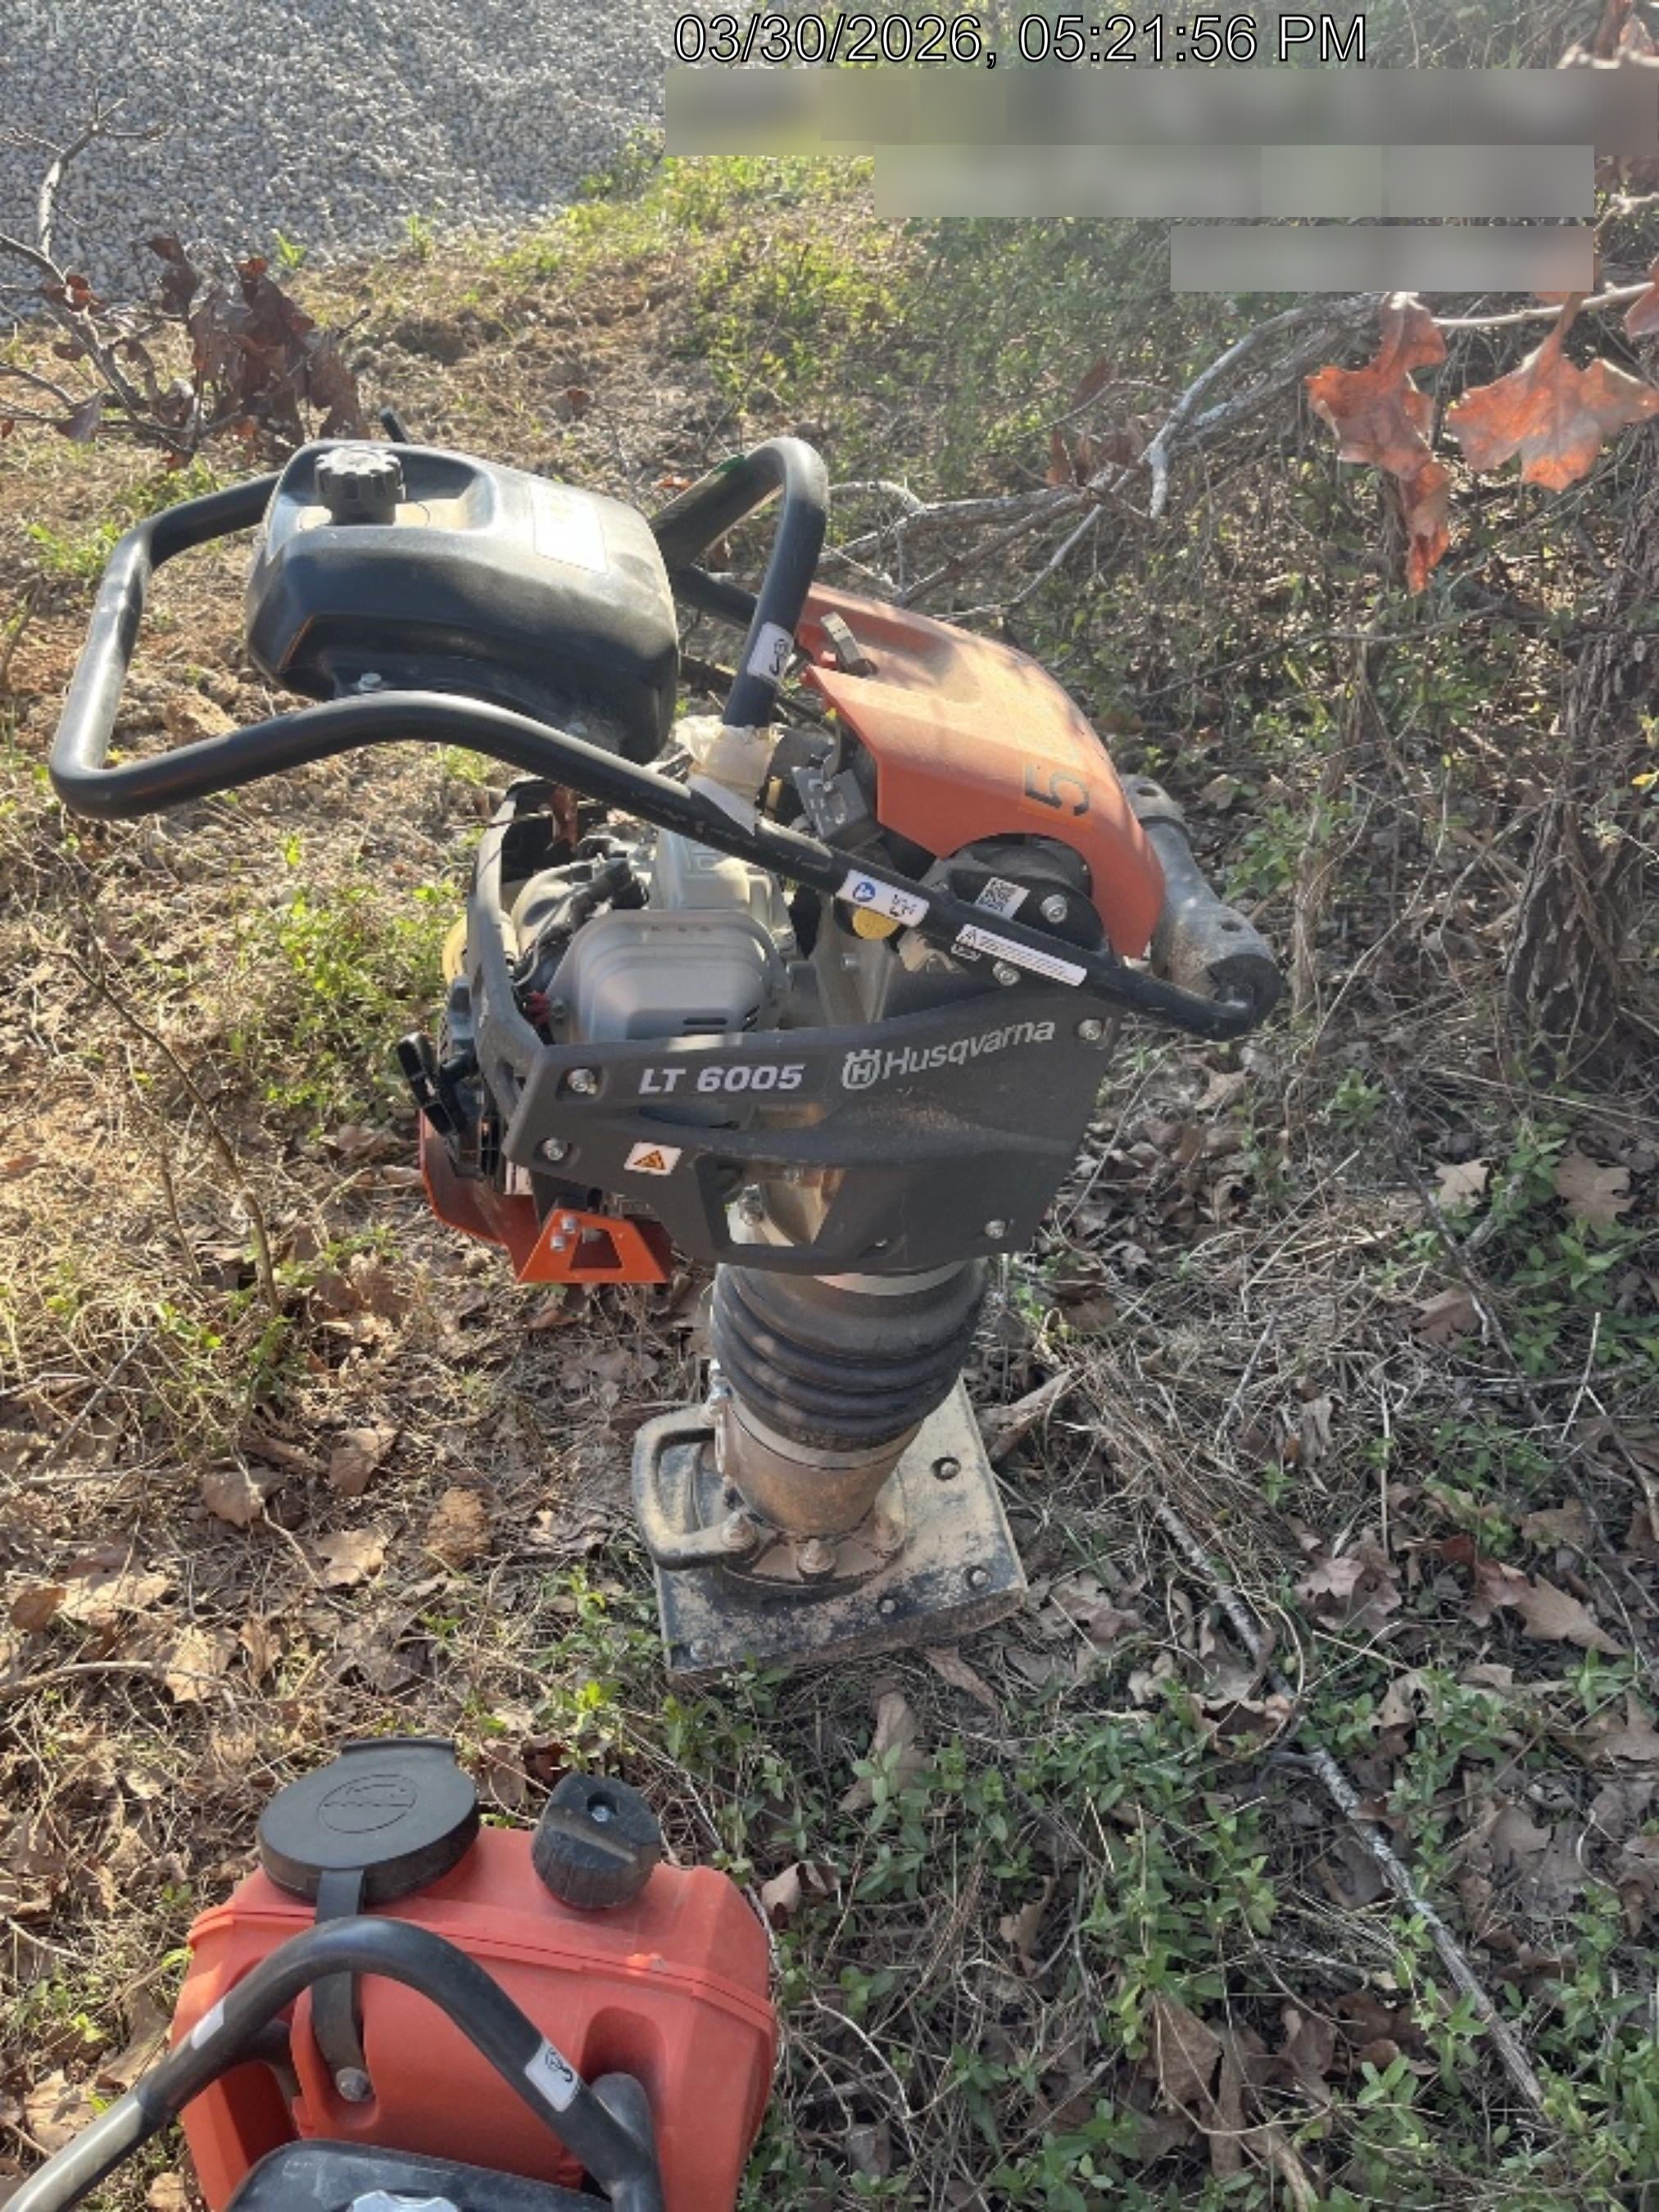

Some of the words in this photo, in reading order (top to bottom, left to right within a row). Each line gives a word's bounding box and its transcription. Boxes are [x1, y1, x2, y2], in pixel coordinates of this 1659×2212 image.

[1024, 763, 1090, 816] 5
[880, 1021, 1057, 1081] Husqvarna
[638, 1067, 687, 1095] LT
[696, 1063, 806, 1093] 6005
